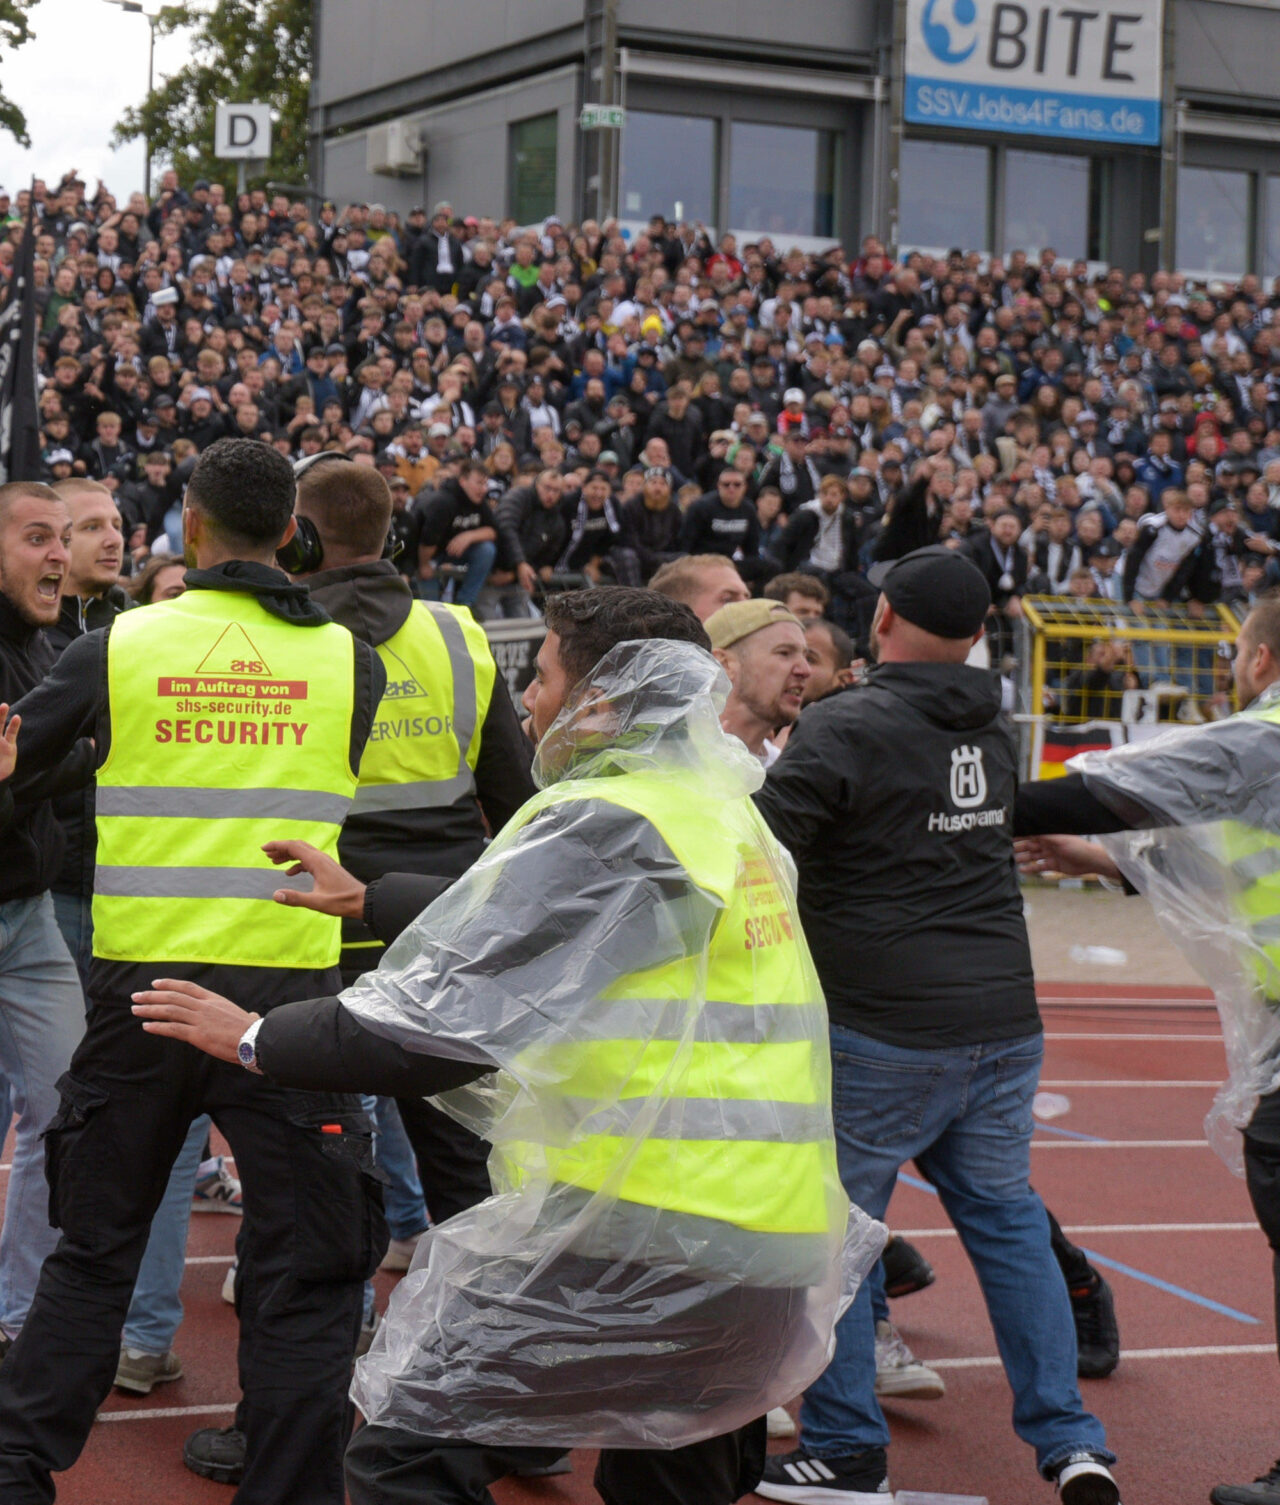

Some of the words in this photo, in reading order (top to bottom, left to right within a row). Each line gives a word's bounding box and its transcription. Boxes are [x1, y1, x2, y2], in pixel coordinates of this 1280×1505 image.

[989, 3, 1142, 81] BITE
[917, 85, 1146, 135] SSV.Jobs4Fans.de
[229, 114, 257, 147] D
[170, 681, 191, 692] im
[196, 681, 256, 697] Auftrag
[260, 686, 289, 695] von
[176, 699, 292, 717] shs-security.de
[155, 719, 308, 745] SECURITY
